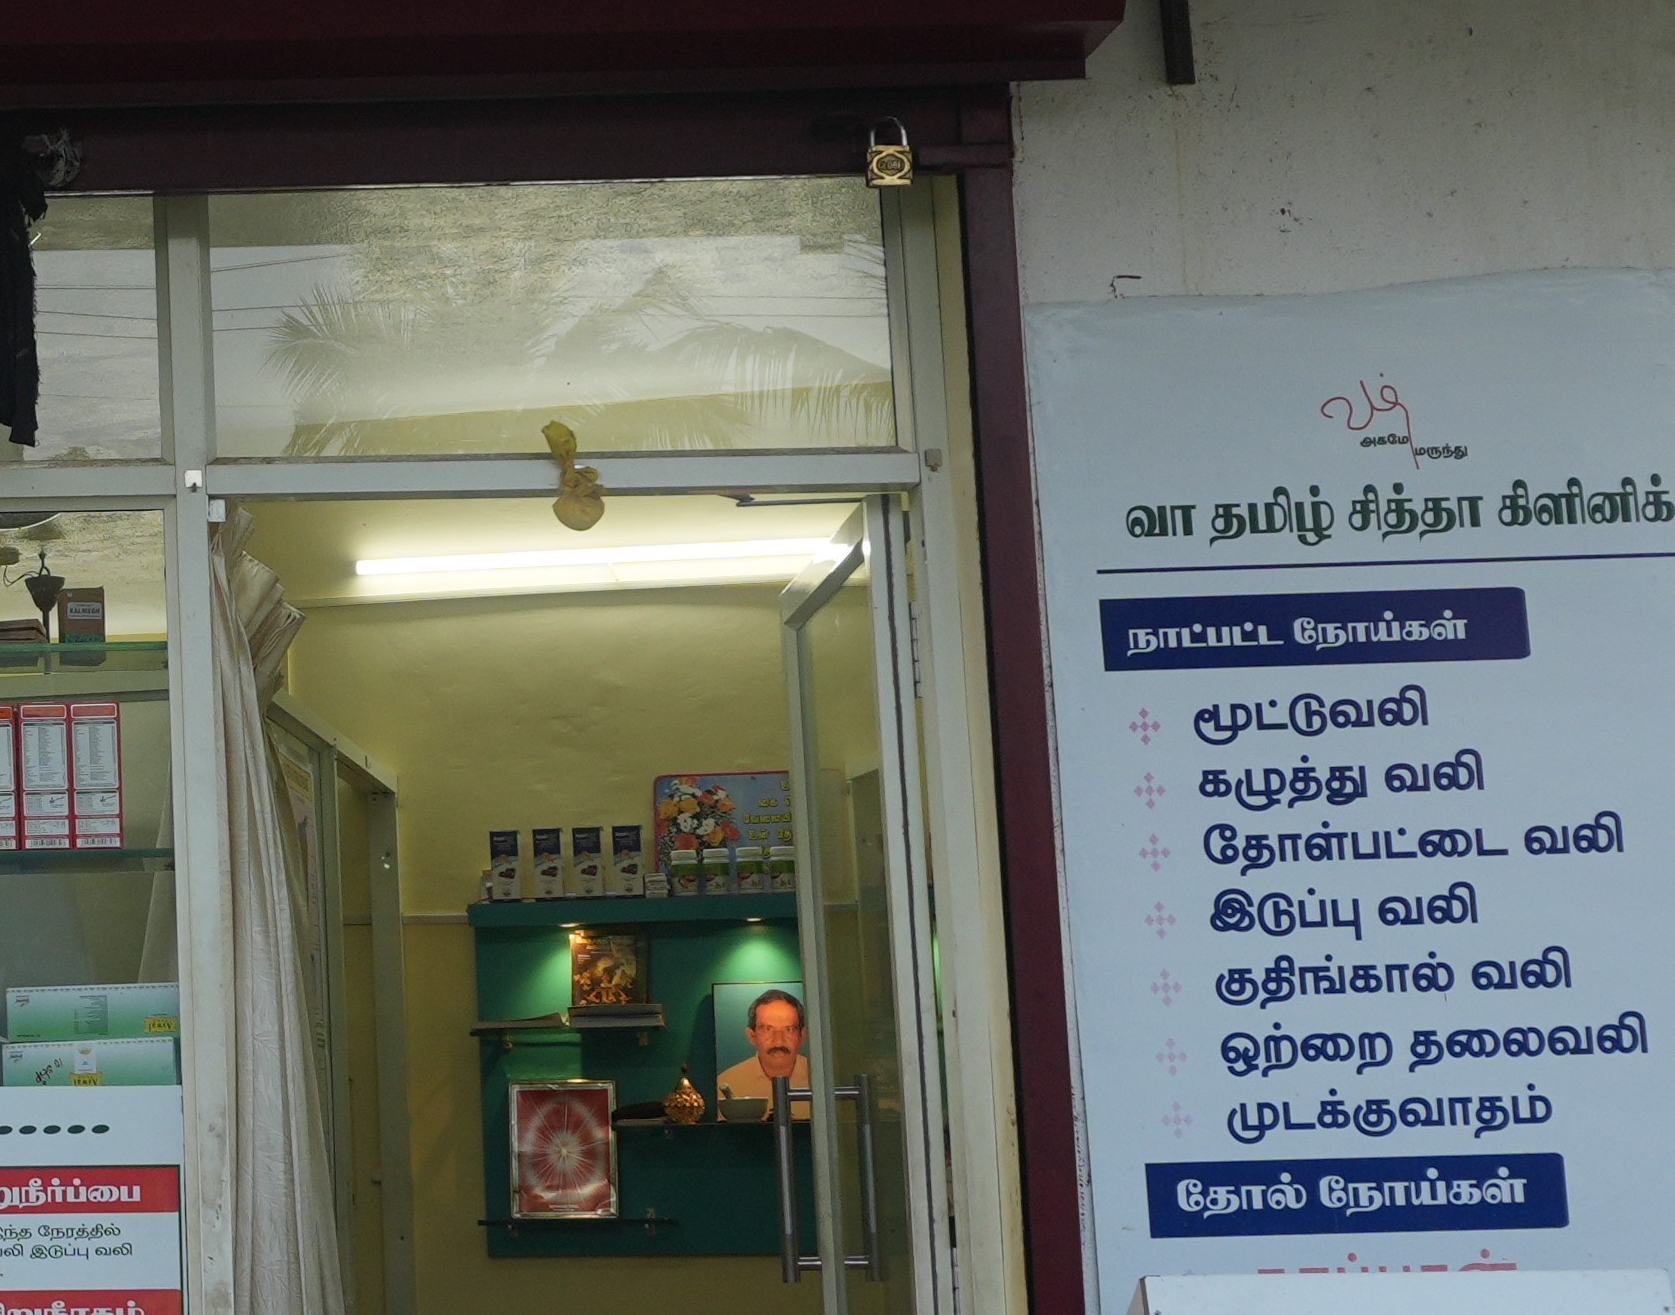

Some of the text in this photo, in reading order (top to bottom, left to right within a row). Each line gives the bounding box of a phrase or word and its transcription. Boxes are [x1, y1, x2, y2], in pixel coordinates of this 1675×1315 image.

[1359, 431, 1410, 450] அகமே
[1414, 441, 1470, 462] மருந்து
[1126, 474, 1675, 547] வா தமிழ் சித்தா கிளினிக்
[1127, 610, 1467, 656] நாட்பட்ட நோய்கள்
[1194, 685, 1428, 745] மூட்டுவலி
[1199, 749, 1484, 811] கழுத்து வலி
[1204, 811, 1623, 876] தோள்பட்டை வலி
[1210, 882, 1478, 940] இடுப்பு வலி
[1216, 946, 1571, 1009] குதிங்கால் வலி
[1221, 1011, 1648, 1077] ஒற்றை தலைவலி
[1227, 1083, 1552, 1144] முடக்குவாதம்
[1177, 1167, 1527, 1219] தோல் நோய்கள்
[30, 1243, 89, 1260] இடுப்பு
[95, 1243, 132, 1256] வலி
[38, 1223, 121, 1241] நேரத்தில்
